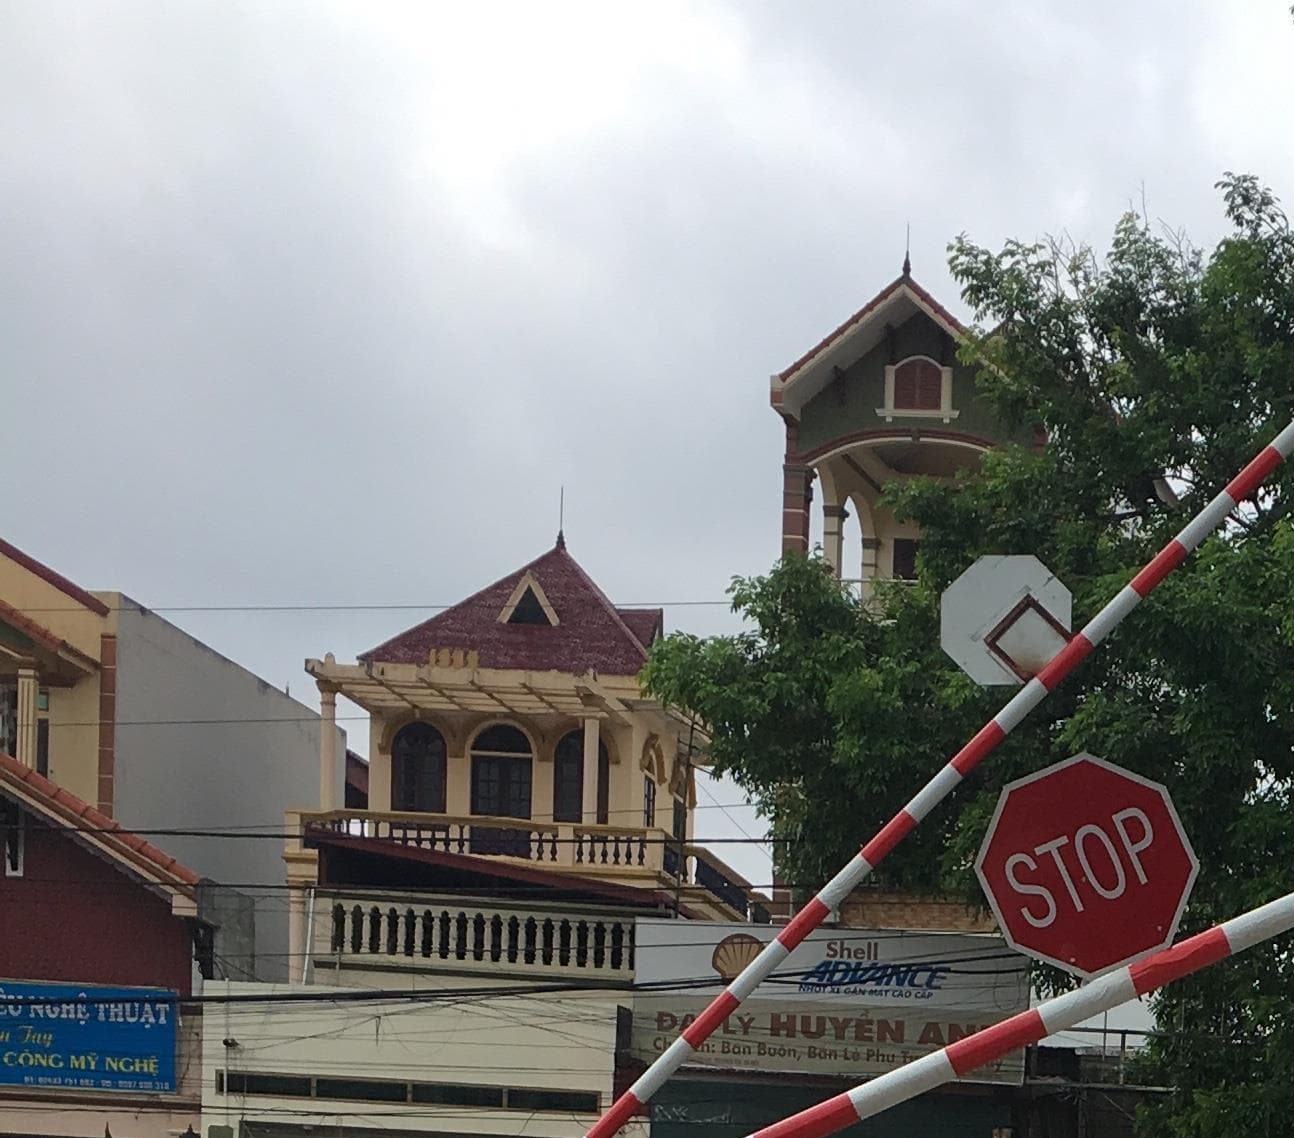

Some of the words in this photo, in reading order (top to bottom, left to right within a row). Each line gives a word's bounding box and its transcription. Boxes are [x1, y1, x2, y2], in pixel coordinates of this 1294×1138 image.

[1005, 807, 1154, 928] STOP
[826, 941, 878, 960] Shell
[800, 960, 951, 990] ADVANCE
[94, 994, 170, 1029] THUẬT
[722, 1012, 756, 1036] LÝ
[3, 1049, 65, 1069] CÔNG
[69, 1051, 100, 1072] MỸ
[104, 1055, 160, 1077] NGHỆ
